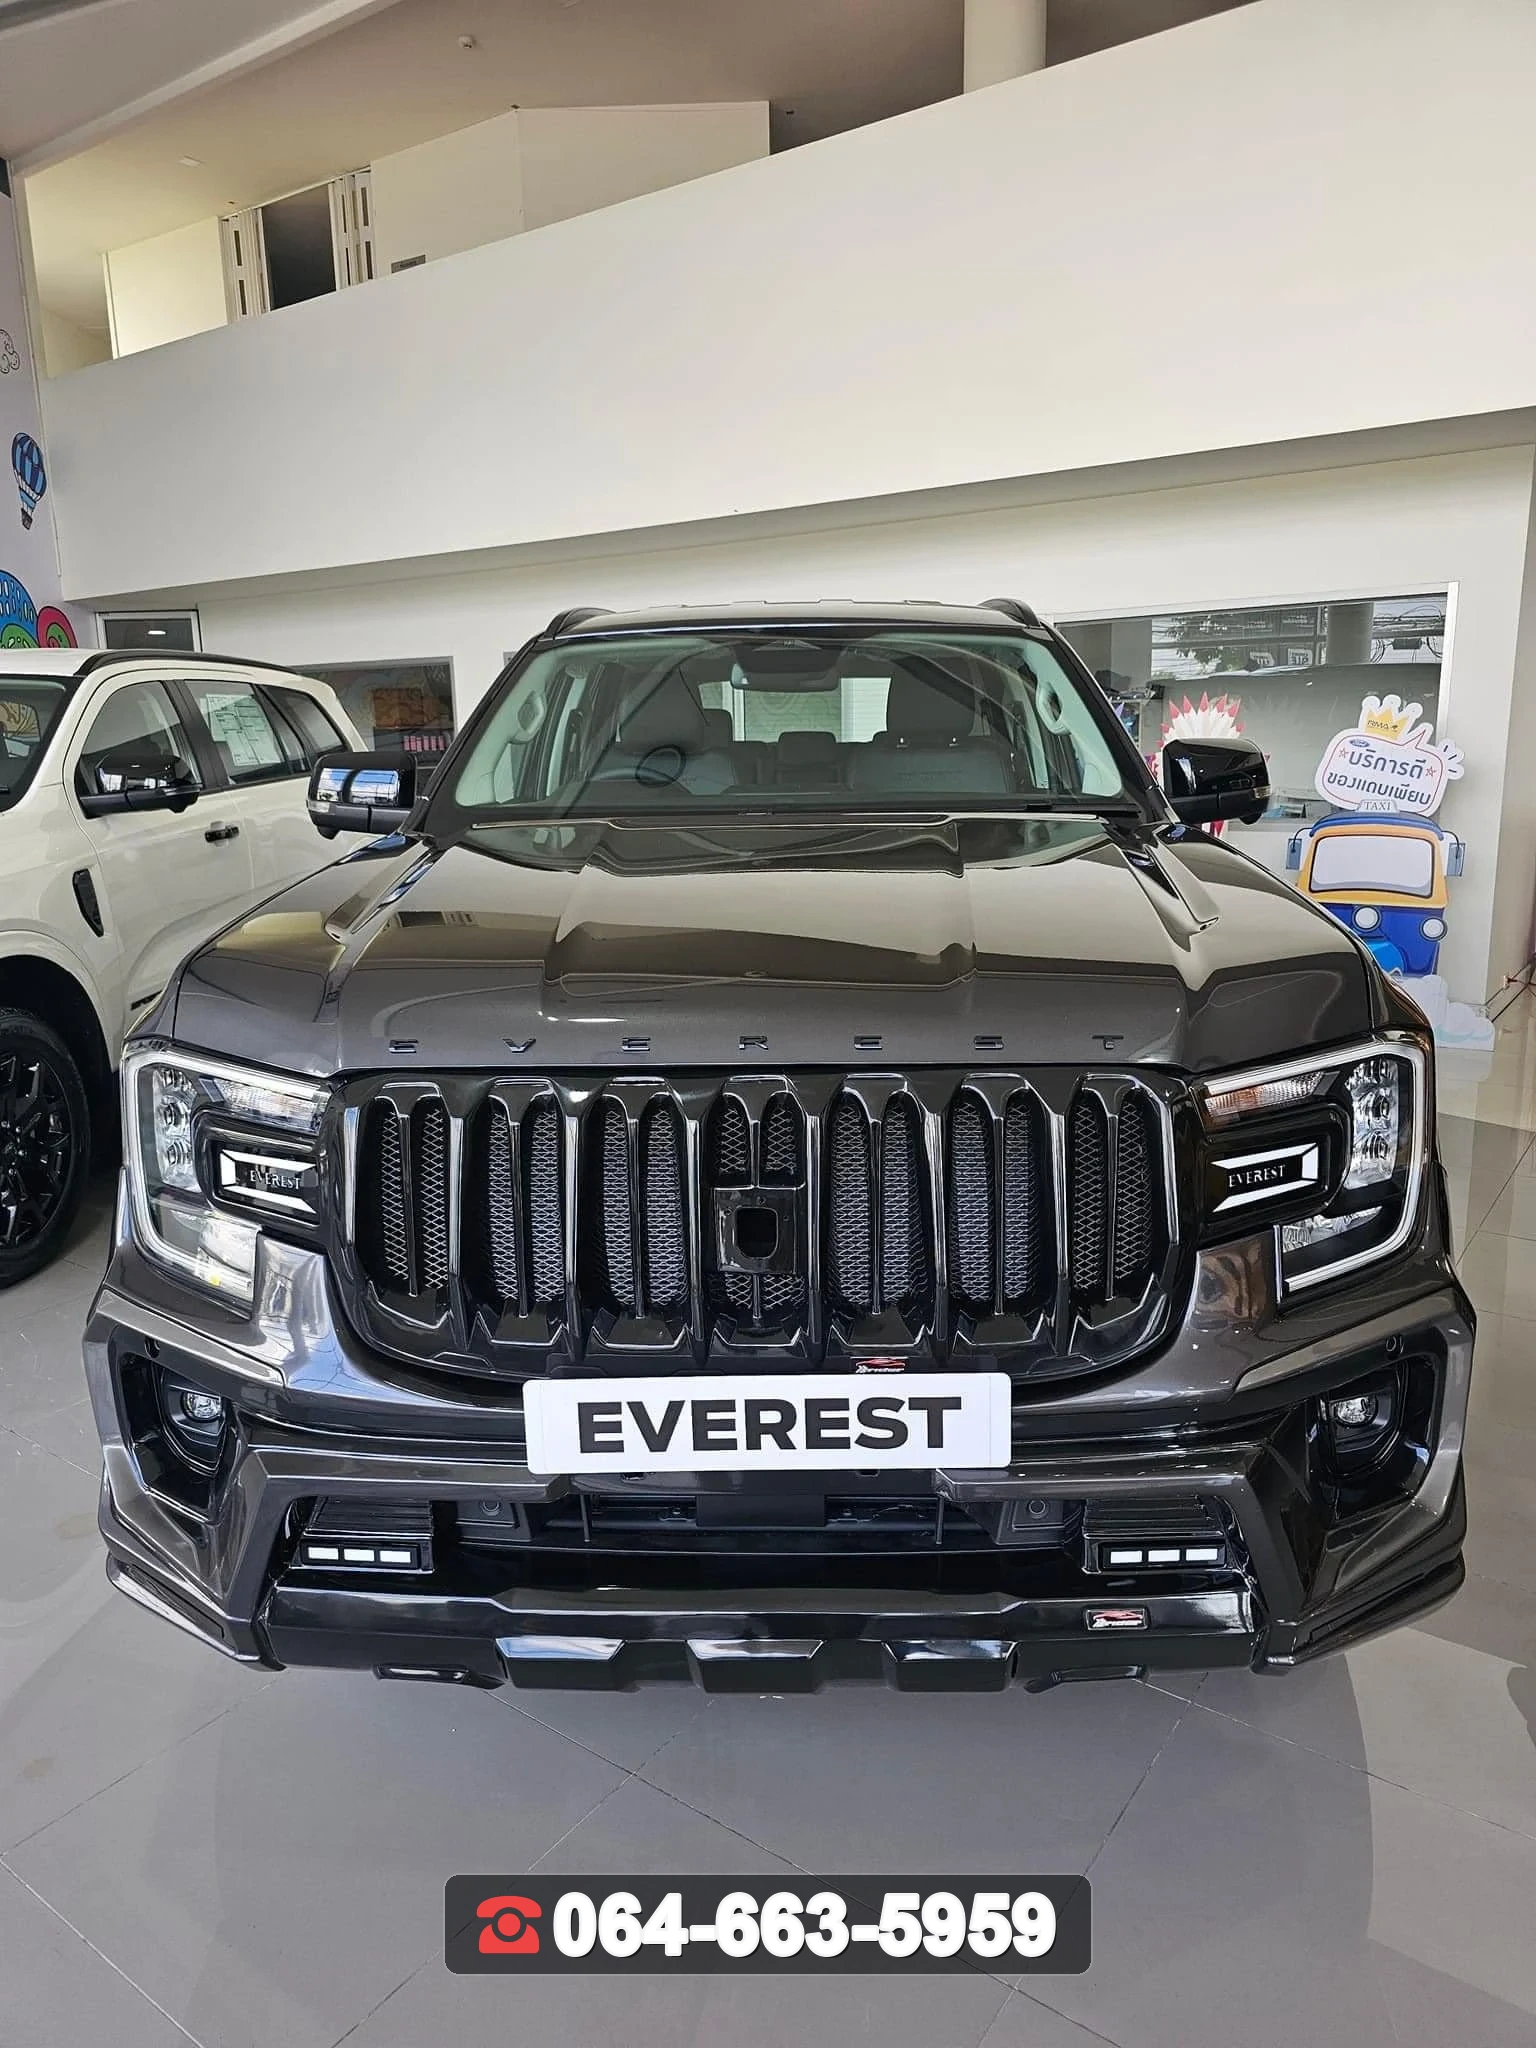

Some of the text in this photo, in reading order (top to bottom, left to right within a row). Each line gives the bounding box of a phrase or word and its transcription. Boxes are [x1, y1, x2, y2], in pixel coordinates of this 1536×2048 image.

[1349, 748, 1426, 779] บริการดี
[1364, 801, 1391, 811] TAXI
[389, 1035, 1124, 1053] EVEREST
[250, 1169, 300, 1190] EVEREST
[1229, 1164, 1286, 1188] EVEREST
[577, 1396, 962, 1454] EVEREST
